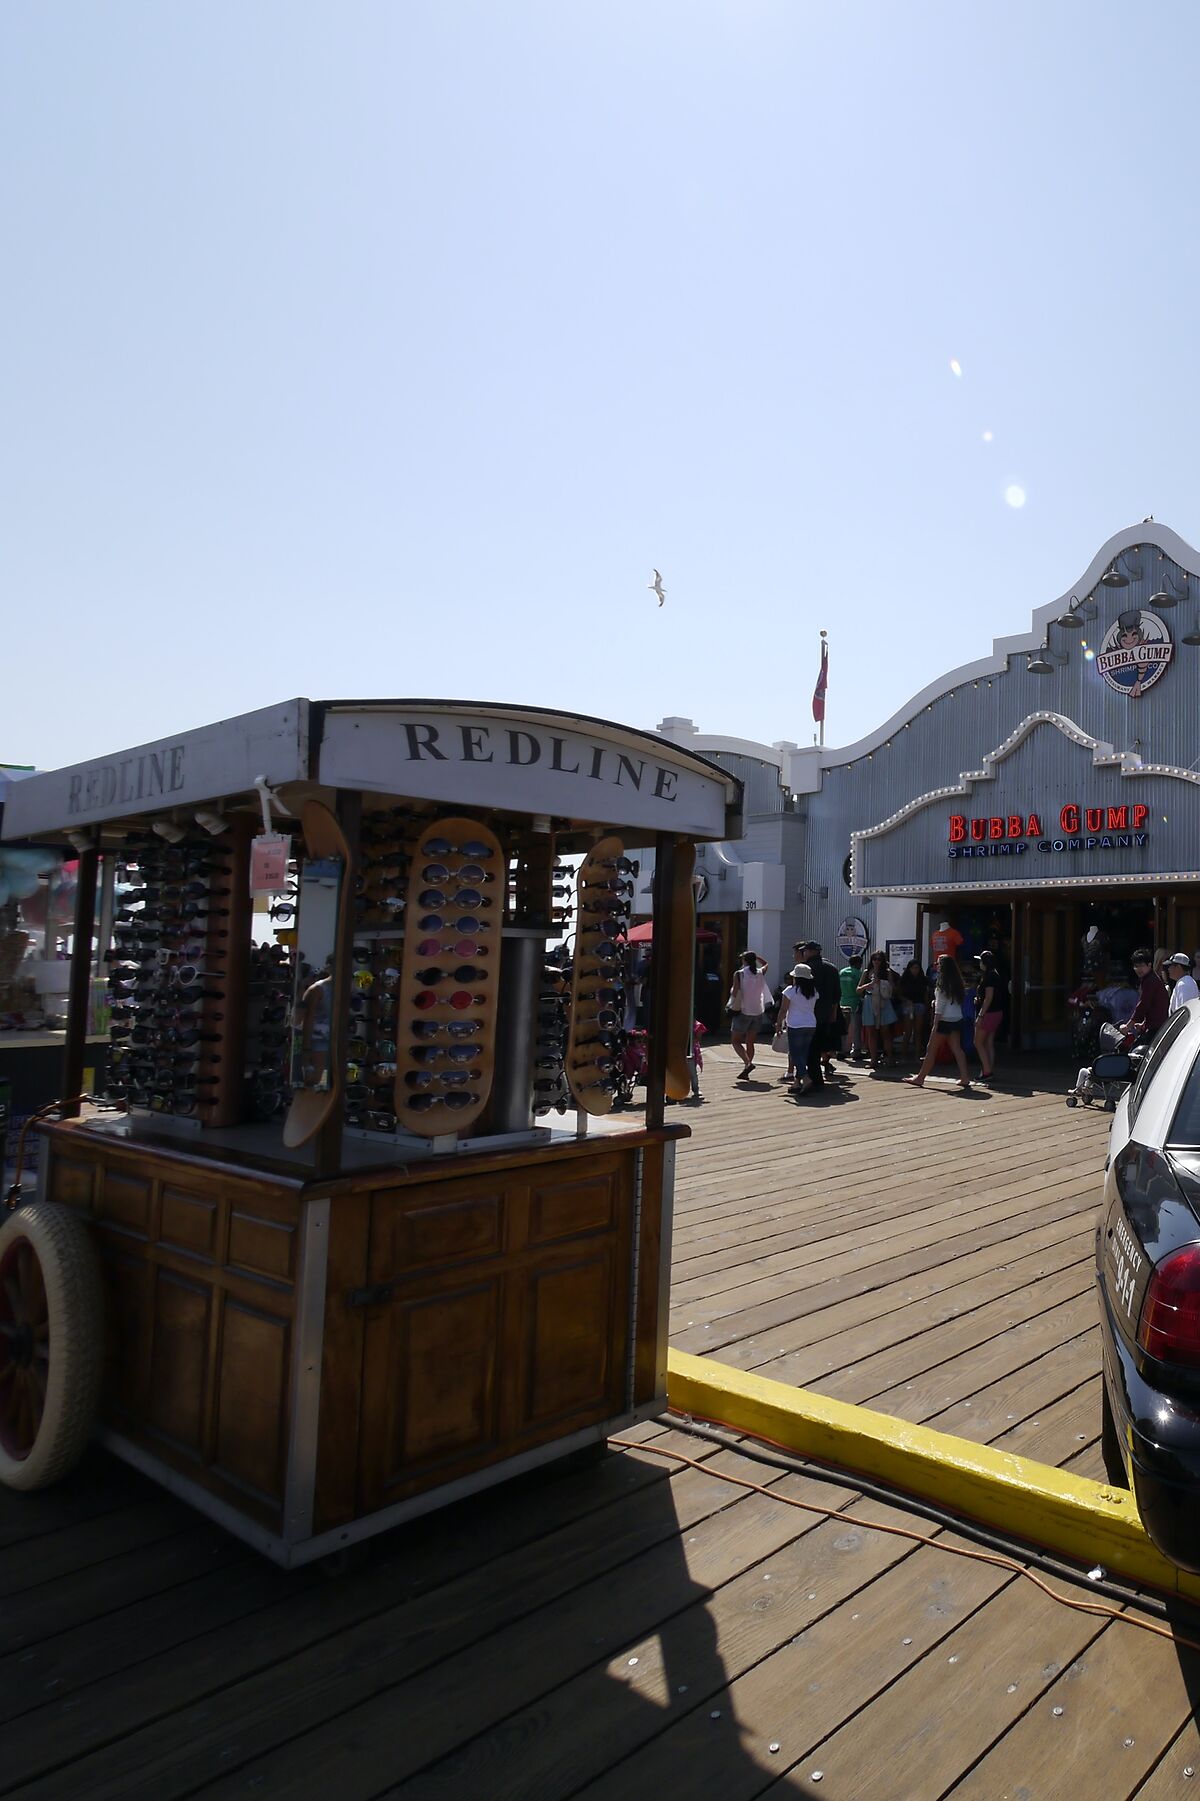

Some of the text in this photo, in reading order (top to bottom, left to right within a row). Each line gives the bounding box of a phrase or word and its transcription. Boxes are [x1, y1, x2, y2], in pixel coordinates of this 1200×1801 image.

[1099, 645, 1171, 671] BUBBA GUMP
[1110, 664, 1137, 676] SHRIMP
[399, 723, 679, 802] REDLINE
[68, 745, 185, 815] REDLINE
[949, 803, 1149, 842] BUBBA GUMP
[949, 833, 1147, 859] SHRIMP COMPANY
[745, 900, 757, 910] 301
[1116, 1217, 1142, 1273] EMERGENCY
